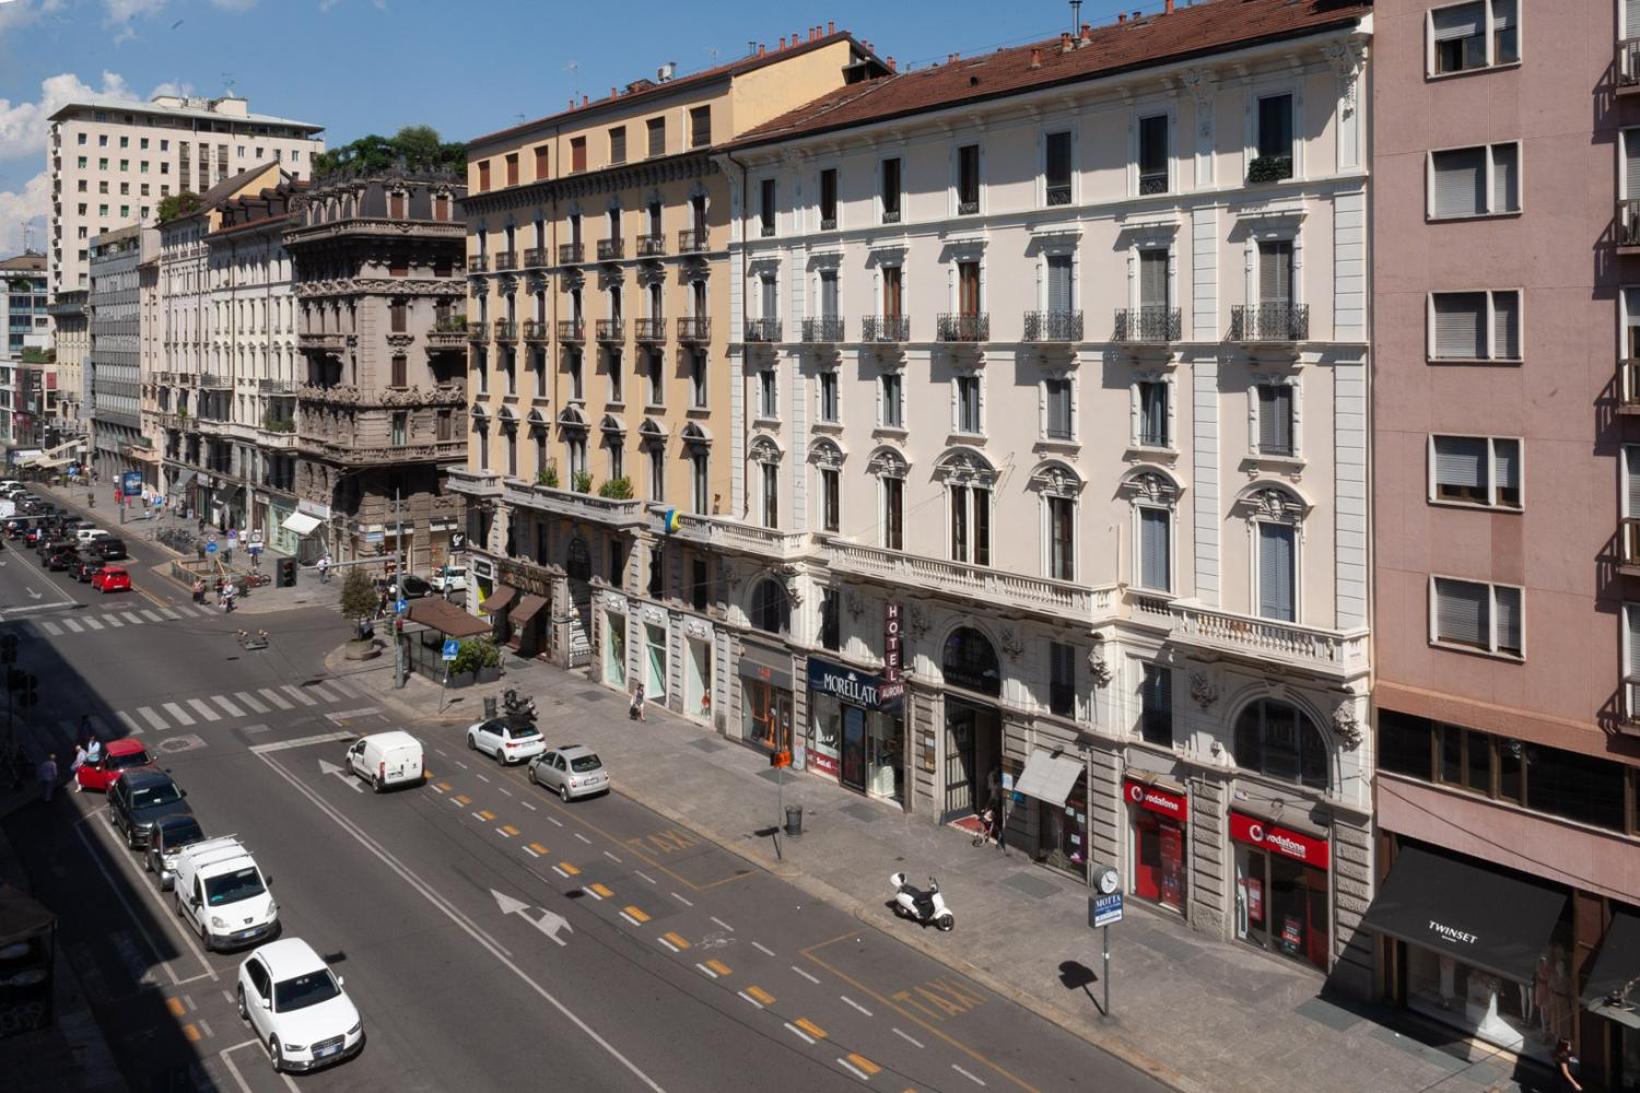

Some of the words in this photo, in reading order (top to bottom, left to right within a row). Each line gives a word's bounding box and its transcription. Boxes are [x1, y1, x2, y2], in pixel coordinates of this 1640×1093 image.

[889, 606, 898, 681] HOTEL
[823, 672, 881, 706] MORELLATO
[882, 684, 904, 698] AURORA
[1145, 794, 1179, 811] vodafone
[1265, 833, 1306, 855] vodafone
[1095, 894, 1121, 908] MOTTA
[1429, 920, 1478, 944] TWINSET
[892, 977, 990, 1020] TAXI
